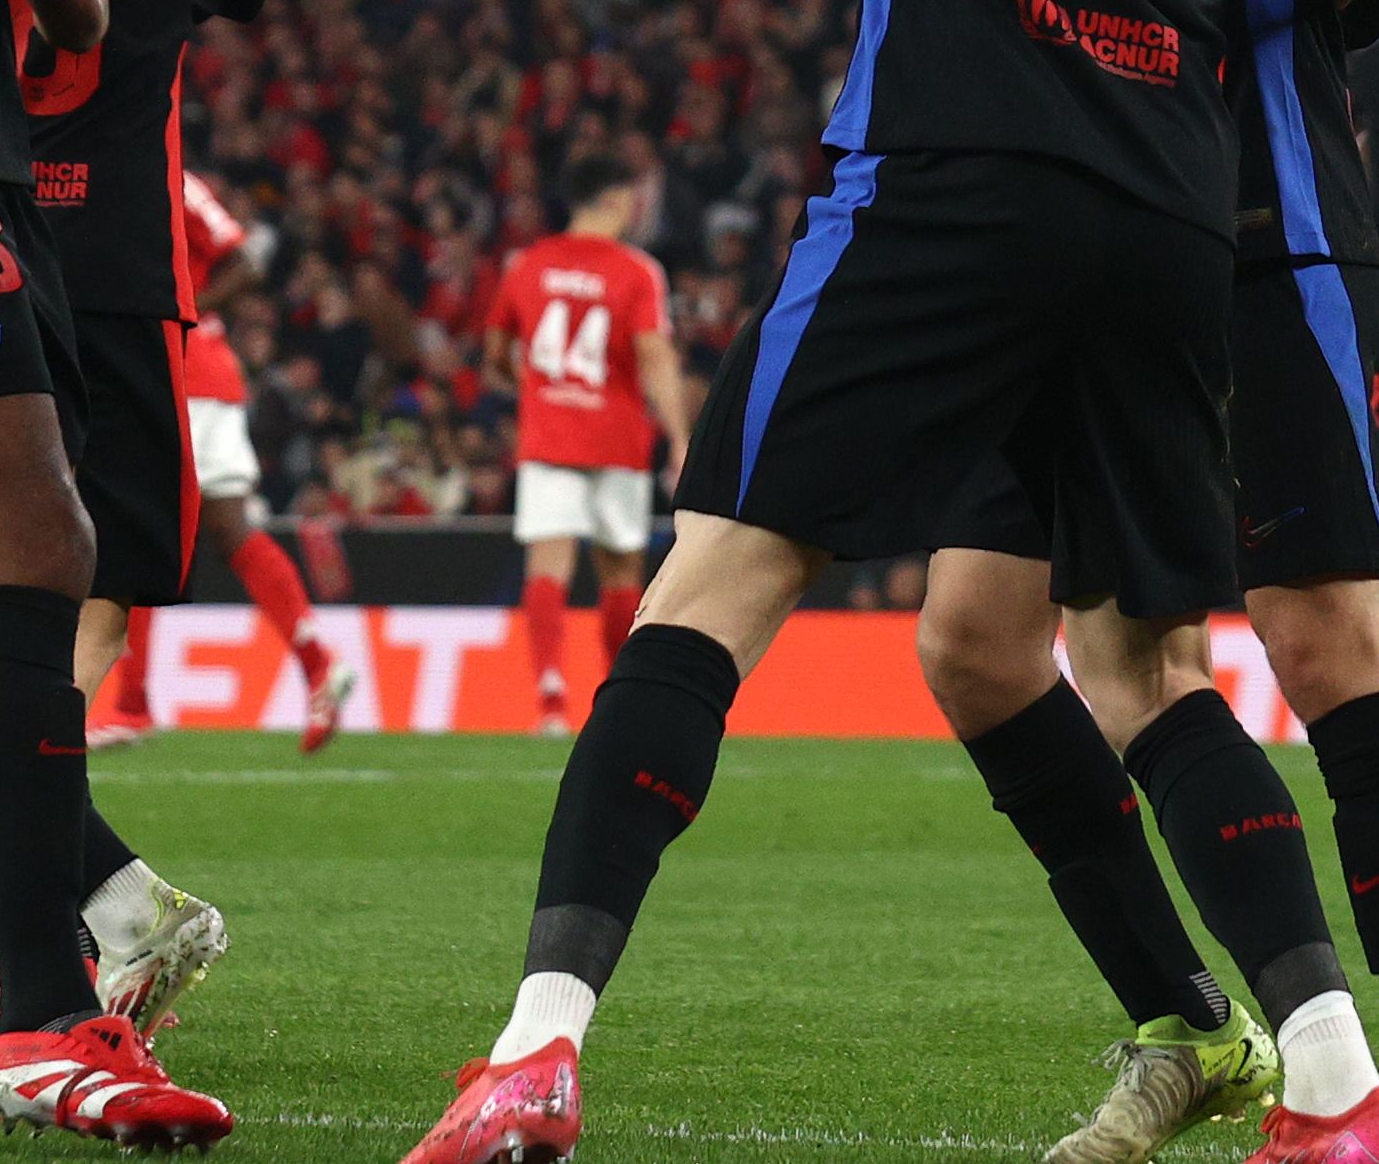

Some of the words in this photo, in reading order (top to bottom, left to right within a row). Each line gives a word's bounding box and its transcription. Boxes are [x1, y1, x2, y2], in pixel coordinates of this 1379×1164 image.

[1077, 9, 1180, 52] UNHCR
[31, 161, 89, 181] HCR
[36, 181, 87, 199] NUR
[529, 297, 611, 388] 44
[145, 606, 514, 731] EAT
